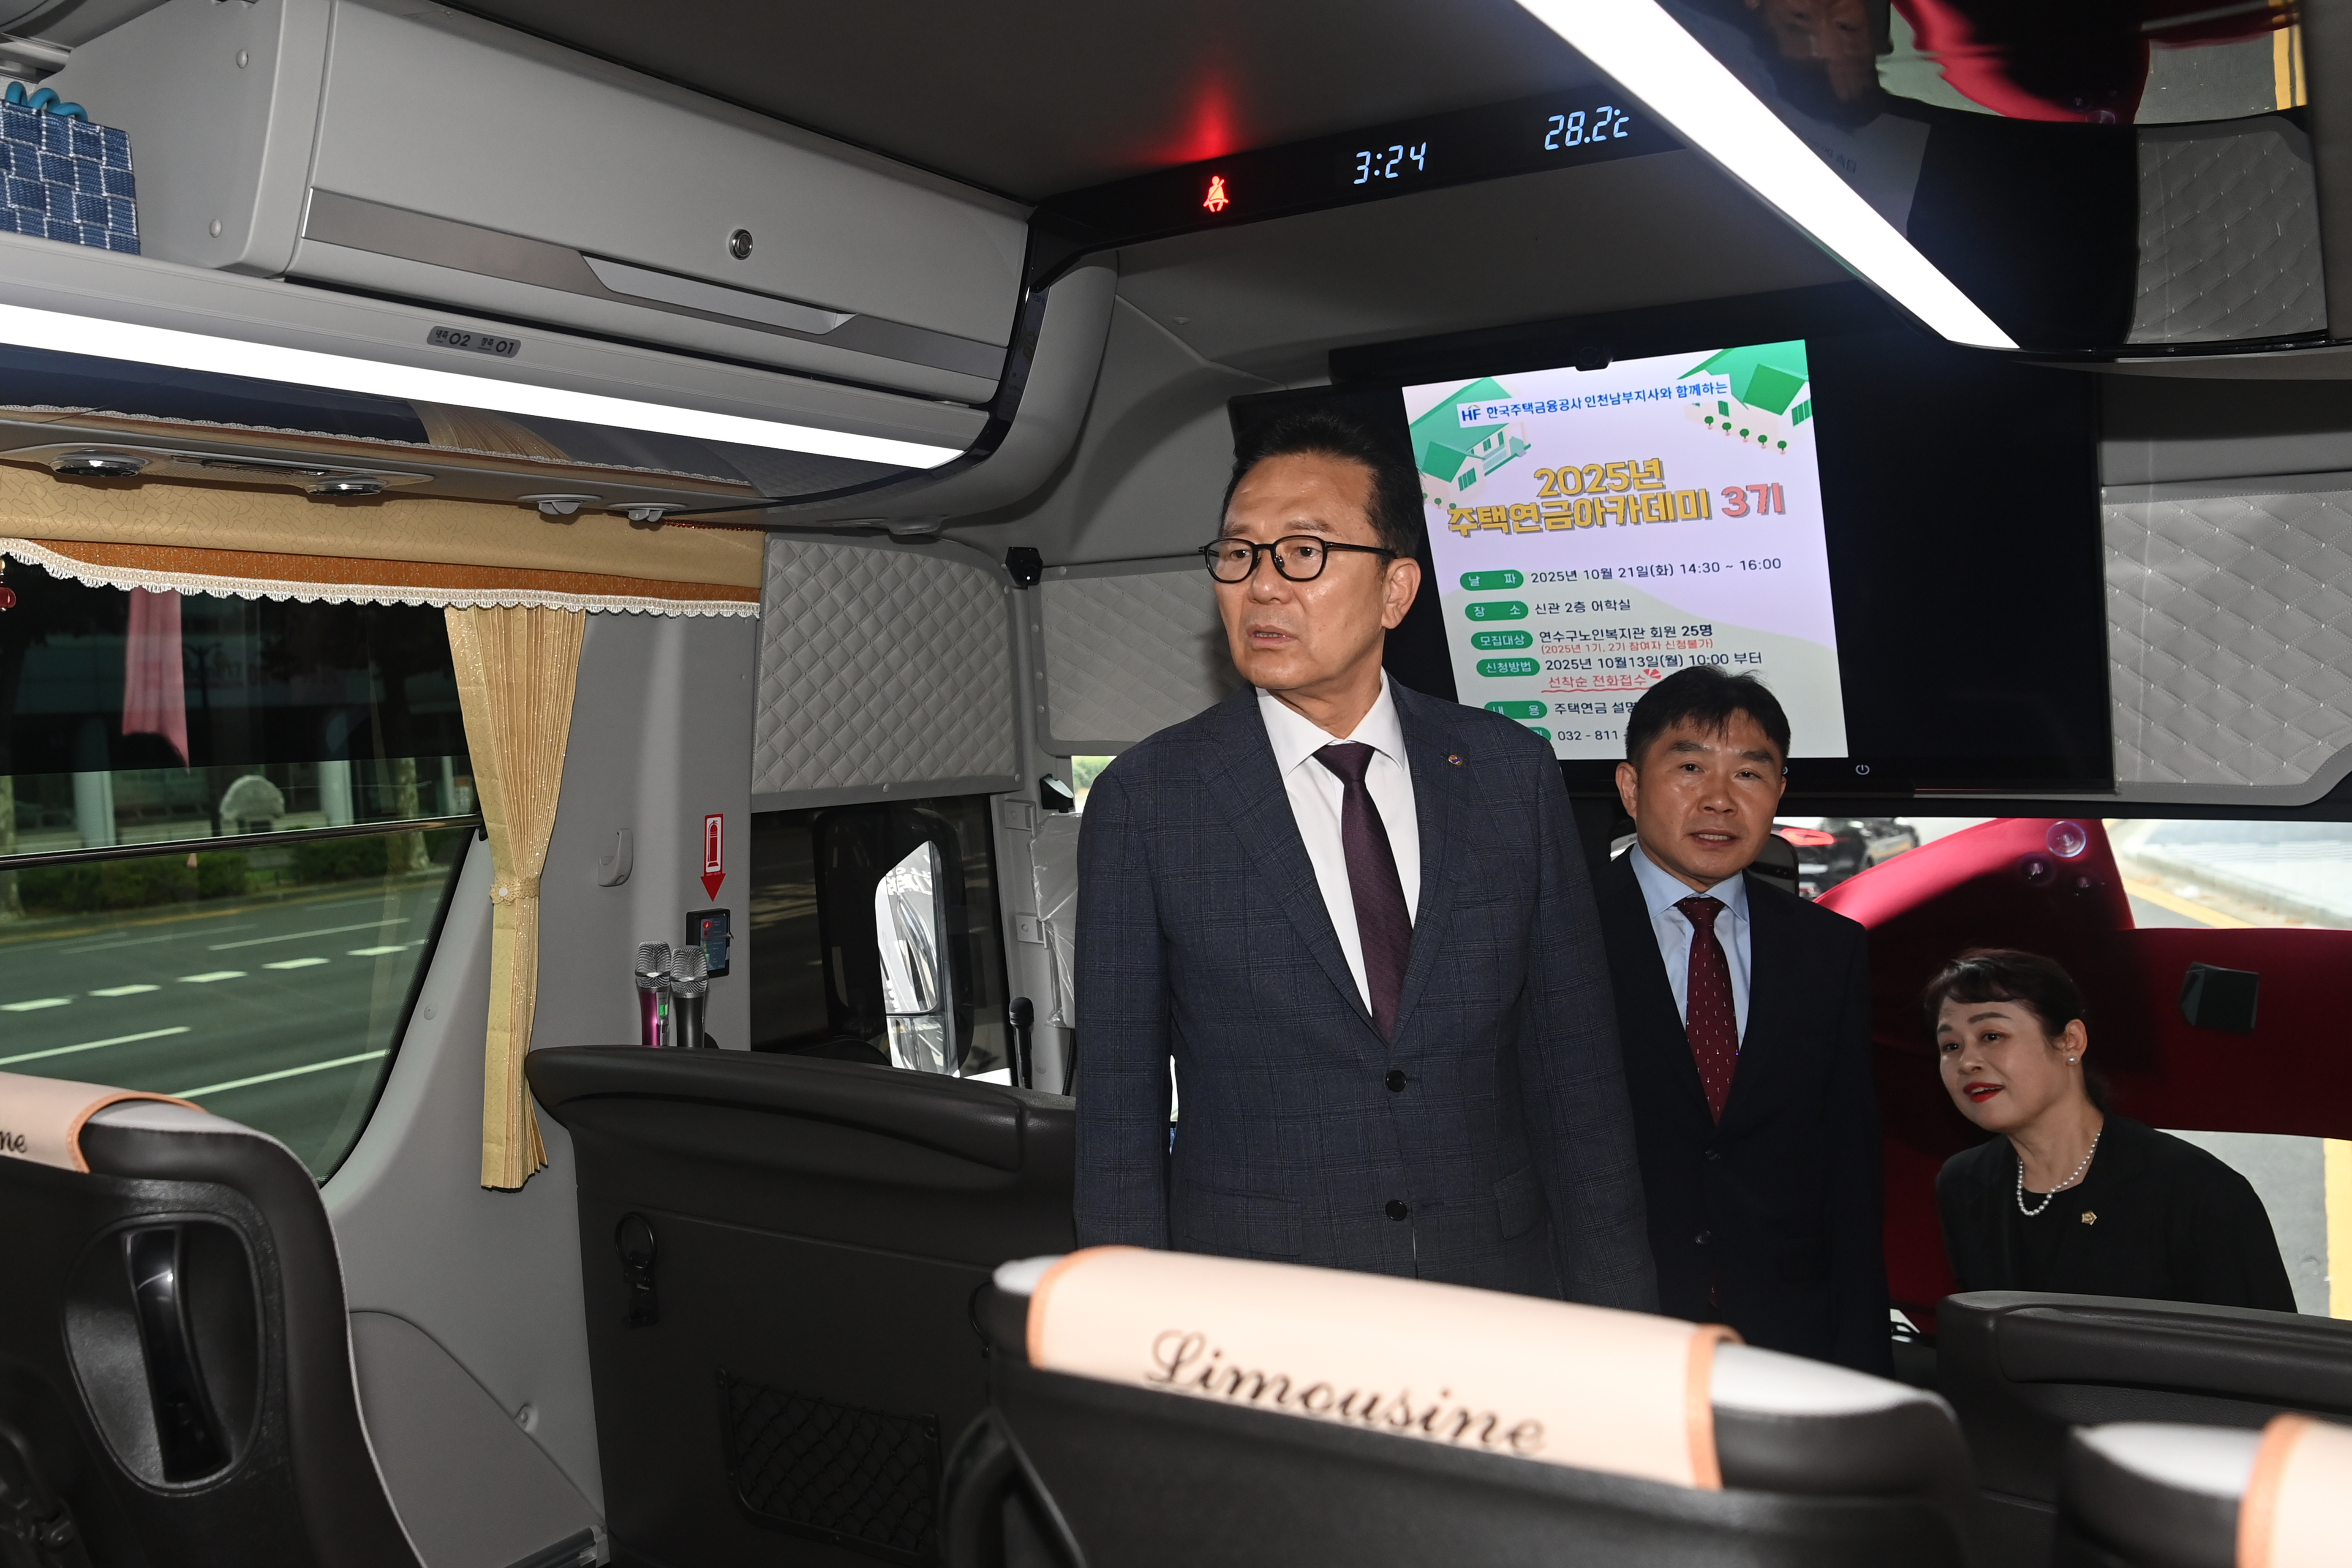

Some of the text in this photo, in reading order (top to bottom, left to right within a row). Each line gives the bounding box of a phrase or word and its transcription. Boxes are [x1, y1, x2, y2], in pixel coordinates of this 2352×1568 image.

[1353, 141, 1426, 185] 3:24
[449, 333, 471, 346] 02
[496, 340, 514, 354] 01
[1462, 381, 1727, 422] HF 한국주택금융공사 인천남부지사와 함께하는
[1534, 458, 1665, 497] 2025년
[1448, 482, 1786, 538] 주택연금아카데미 3기
[1531, 570, 1578, 583] 2025년
[1583, 567, 1613, 580] 10월
[1618, 564, 1674, 578] 21일(화)
[1680, 562, 1720, 574] 14:30
[1740, 558, 1781, 571] 16:00
[1535, 599, 1631, 615] 신관 2층 어학실
[1480, 634, 1524, 646] 모집대상
[1539, 624, 1713, 643] 연수구노인복지관 회원 25명
[1541, 644, 1581, 655] (2025년
[1609, 643, 1625, 651] 2기
[1629, 641, 1661, 651] 참여자
[1486, 661, 1532, 673] 신청방법
[1545, 658, 1592, 670] 2025년
[1689, 653, 1729, 666] 10:00
[1734, 652, 1762, 664] 부터
[1549, 674, 1647, 689] 선착순 전화접수
[1554, 702, 1607, 715] 주택연금
[1558, 730, 1582, 741] 032
[1595, 730, 1618, 740] 811
[1144, 1329, 1547, 1453] Limousine
